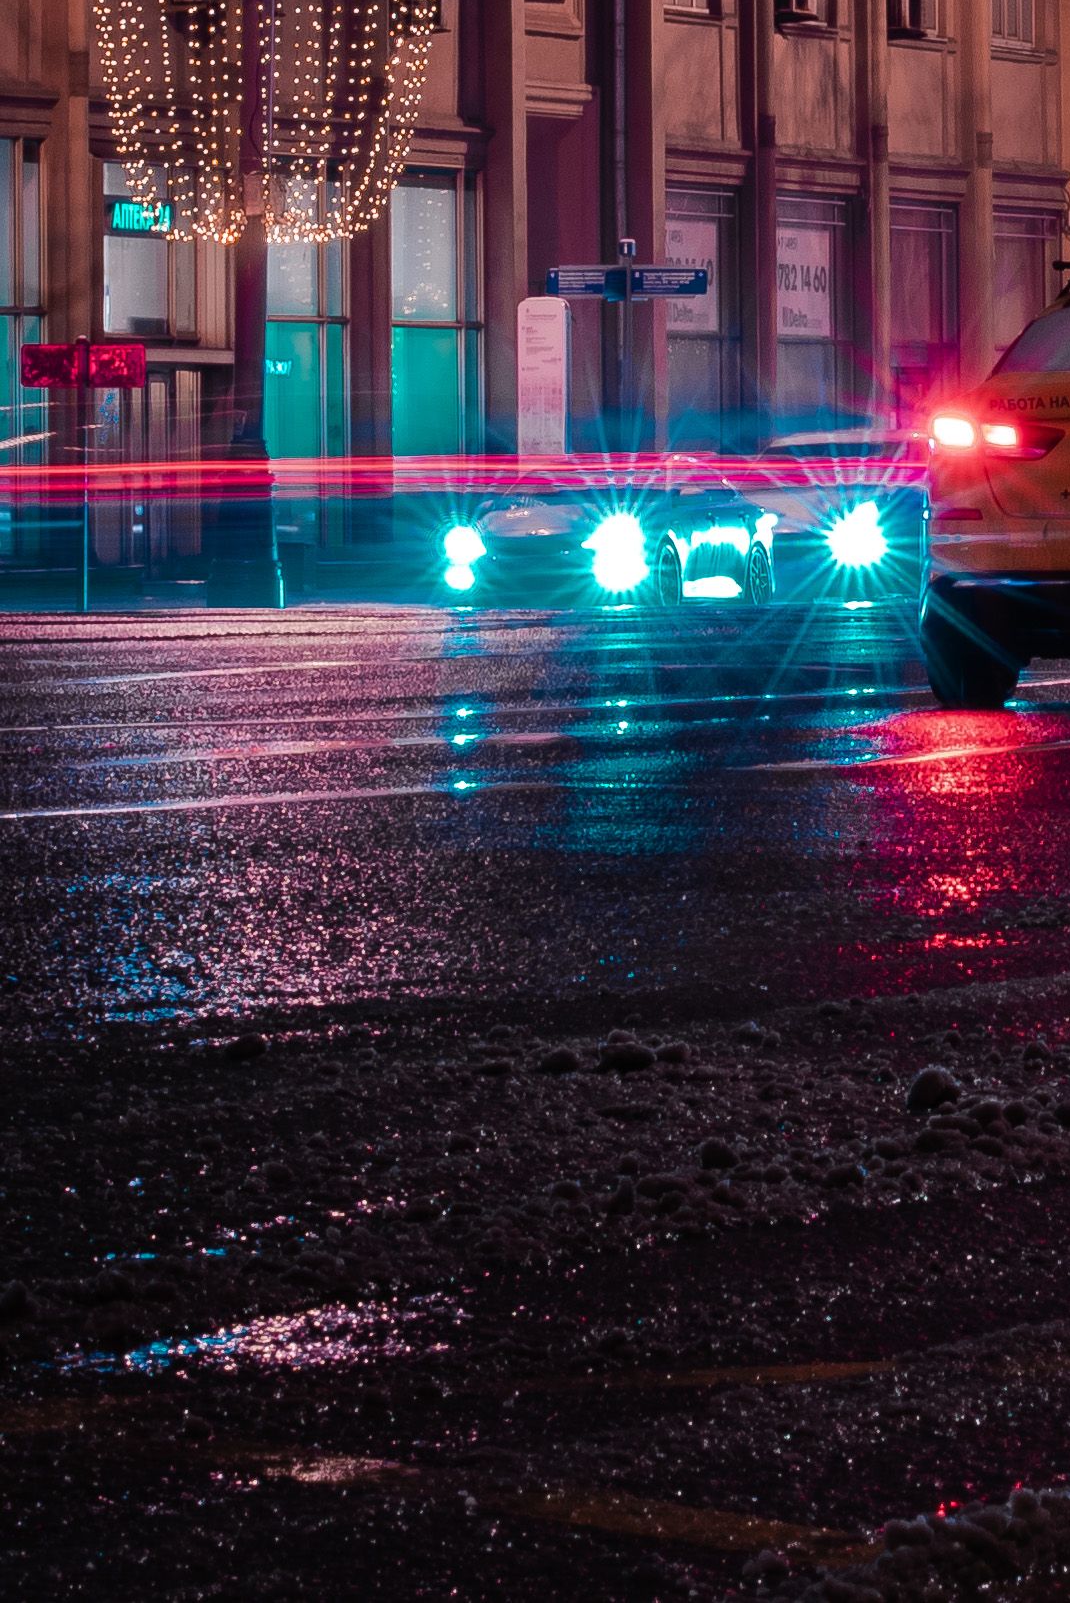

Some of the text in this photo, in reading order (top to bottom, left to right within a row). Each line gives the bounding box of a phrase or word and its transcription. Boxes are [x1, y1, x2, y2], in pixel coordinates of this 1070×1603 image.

[112, 203, 155, 230] АПТЕКА
[813, 266, 827, 293] 60
[989, 397, 1044, 411] РАБОТА
[1049, 396, 1070, 409] НА
